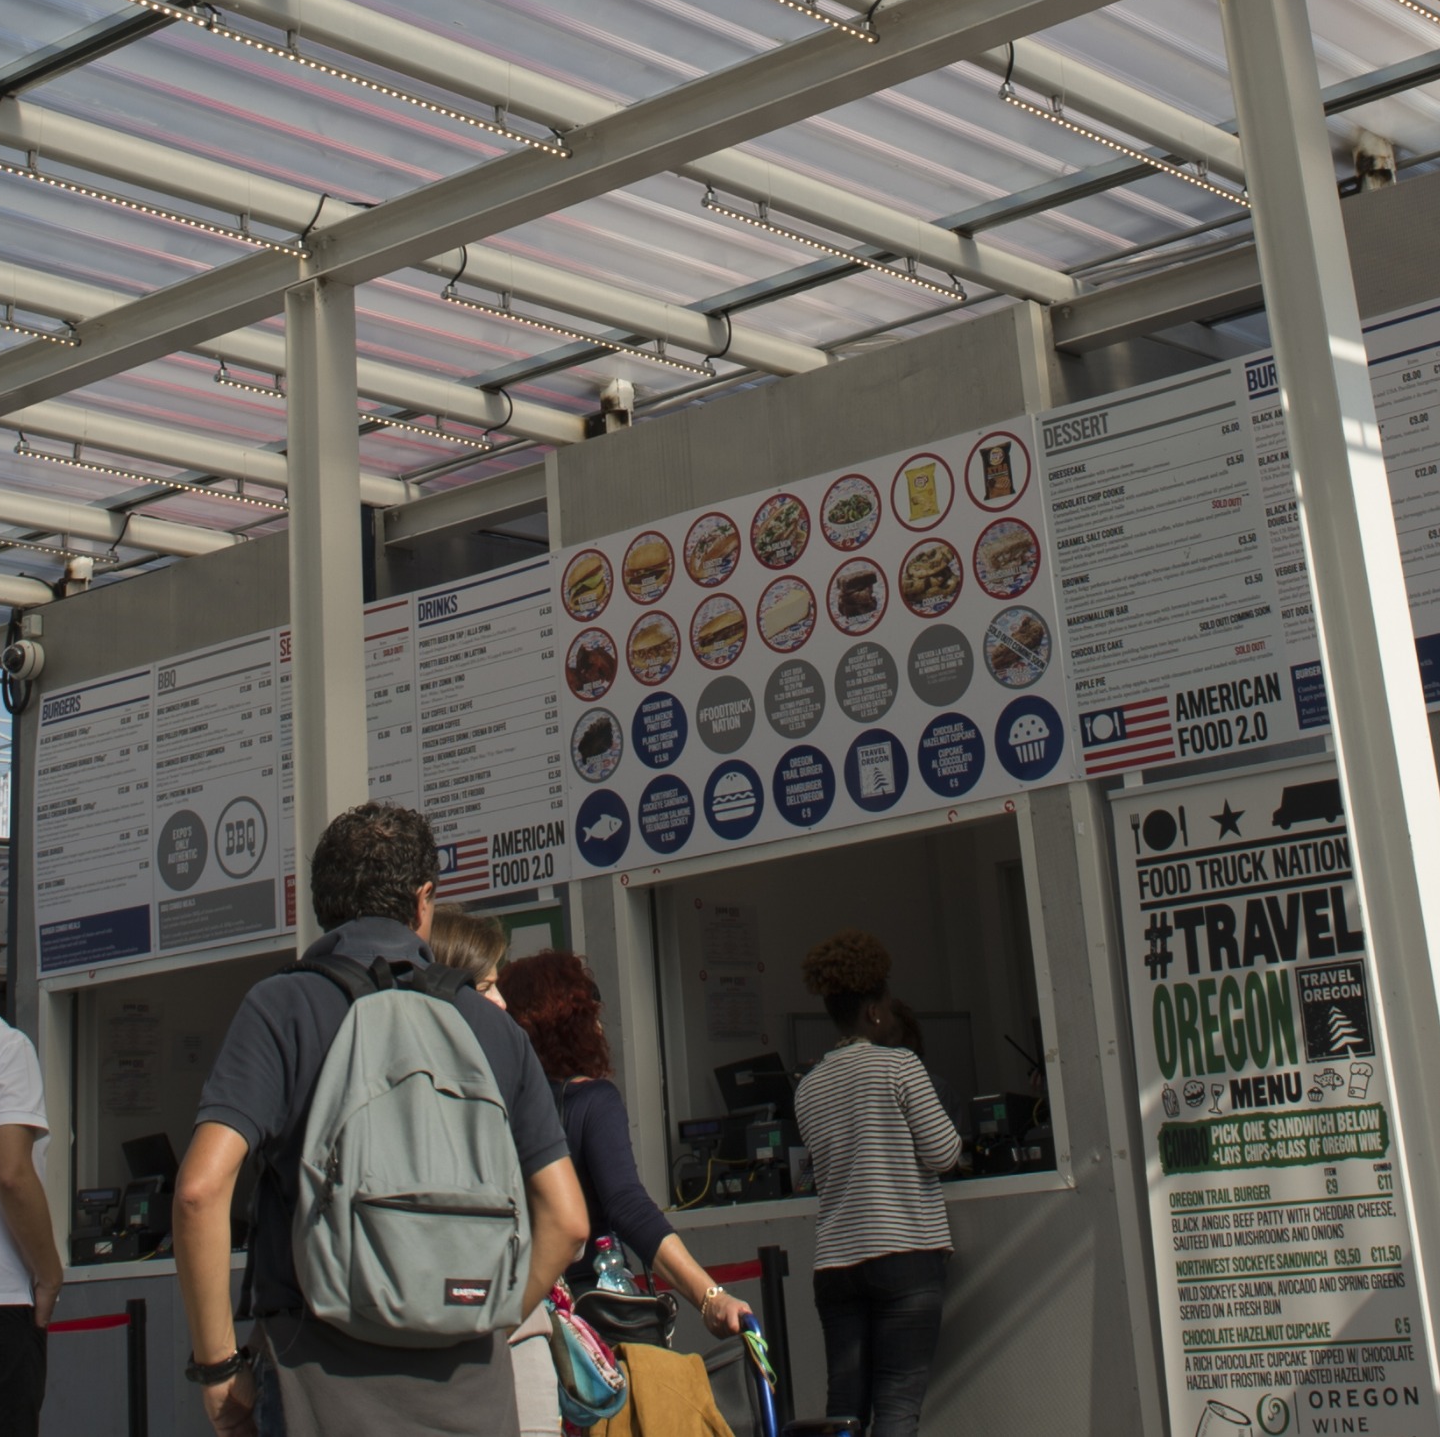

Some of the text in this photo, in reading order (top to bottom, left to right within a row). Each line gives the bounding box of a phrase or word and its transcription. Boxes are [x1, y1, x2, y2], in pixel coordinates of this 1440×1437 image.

[1043, 412, 1109, 449] DESSERT
[1048, 464, 1086, 482] CHEESECAKE
[1052, 486, 1125, 512] CHOCOLATE CHIP COOKIE
[1212, 499, 1227, 509] SOLD
[1057, 525, 1124, 550] CARAMEL SALT COOKIE
[1062, 574, 1090, 588] BROWNIE
[418, 594, 458, 621] DRINKS
[1067, 605, 1129, 627] MARSHMALLOW BAR
[1199, 621, 1215, 633] SOLD
[1230, 611, 1254, 626] COMING
[1255, 605, 1271, 617] SOON
[1071, 640, 1123, 659] CHOCOLATE CAKE
[1234, 645, 1250, 656] SOLD
[158, 669, 176, 690] BBQ
[1075, 677, 1105, 692] APPLE PIE
[42, 695, 81, 721] BURGERS
[1175, 672, 1282, 722] AMERICAN
[699, 698, 751, 723] #FOODTRUCK
[712, 715, 740, 734] NATION
[933, 722, 963, 736] CHOCOLATE
[1178, 711, 1268, 757] FOOD 2.0
[861, 747, 886, 756] TRAVEL
[861, 755, 889, 764] OREGON
[175, 839, 189, 850] ONLY
[225, 818, 256, 858] BBQ
[492, 820, 565, 859] AMERICAN
[168, 849, 197, 864] AUTHENTIC
[1137, 837, 1351, 900] FOOD TRUCK NATION
[493, 853, 553, 889] FOOD 2.0
[1144, 886, 1364, 980] #TRAVEL
[1301, 969, 1355, 986] TRAVEL
[1303, 983, 1362, 1002] OREGON
[1153, 969, 1298, 1080] OREGON
[1230, 1072, 1302, 1109] MENU
[1212, 1110, 1379, 1145] PICK ONE SANDWICH BELOW
[1163, 1126, 1208, 1168] COMBO
[1310, 1140, 1320, 1156] OF
[1322, 1136, 1356, 1155] OREGON
[1359, 1132, 1382, 1151] WINE
[1169, 1174, 1393, 1208] OREGON TRAIL BURGER €9 €11
[1172, 1201, 1396, 1233] BLACK ANGUS BEEF PATTY WITH CHEDDAR CHEESE,
[1173, 1224, 1344, 1251] SAUTEED WILD MUSHROOMS AND ONIONS
[1176, 1257, 1230, 1277] NORTHWEST
[1232, 1254, 1275, 1273] SOCKEYE
[1277, 1250, 1328, 1269] SANDWICH
[1371, 1245, 1401, 1262] €11.50
[1178, 1272, 1405, 1302] WILD SOCKEYE SALMON, AVOCADO AND SPRING GREENS
[1179, 1299, 1281, 1320] SERVED ON A FRESH BUN
[1183, 1327, 1235, 1346] CHOCOLATE
[1237, 1324, 1284, 1343] HAZELNUT
[1286, 1322, 1331, 1340] CUPCAKE
[1185, 1357, 1191, 1371] A
[1193, 1355, 1212, 1371] RICH
[1215, 1353, 1264, 1370] CHOCOLATE
[1267, 1350, 1307, 1366] CUPCAKE
[1310, 1348, 1344, 1365] TOPPED
[1361, 1345, 1414, 1362] CHOCOLATE
[1186, 1366, 1385, 1391] HAZELNUT FROSTING AND TOASTED HAZELNUTS
[1309, 1386, 1418, 1408] OREGON
[1313, 1417, 1368, 1433] WINE
